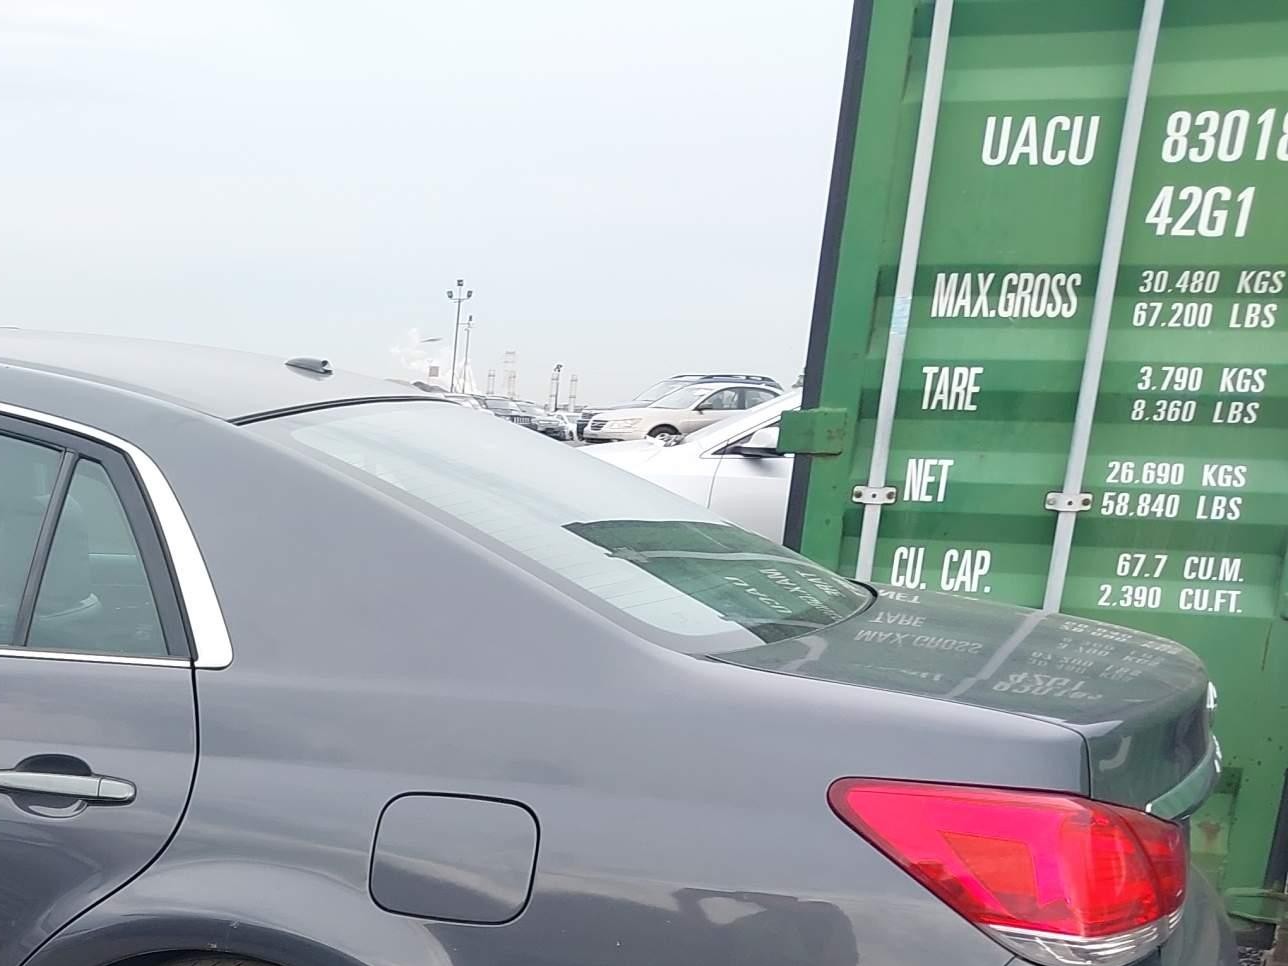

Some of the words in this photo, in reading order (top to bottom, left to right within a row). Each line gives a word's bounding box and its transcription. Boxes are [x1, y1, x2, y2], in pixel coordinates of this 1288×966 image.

[981, 115, 1100, 166] UACU
[1145, 186, 1256, 237] 42G1
[931, 273, 1082, 318] MAX.GROSS
[1139, 270, 1220, 293] 30.480
[1236, 270, 1286, 294] KGS
[1132, 302, 1213, 327] 67.200
[1229, 303, 1278, 328] LBS
[922, 366, 984, 410] TARE
[1137, 366, 1203, 391] 3.790
[1219, 367, 1267, 393] KGS
[1131, 399, 1197, 422] 8.360
[1212, 401, 1260, 424] LBS
[903, 458, 954, 502] NET
[1106, 461, 1184, 485] 26.690
[1202, 464, 1247, 487] KGS
[1101, 492, 1180, 517] 58.840
[1196, 495, 1243, 520] LBS
[890, 546, 927, 590] CU.
[940, 548, 991, 593] CAP.
[1116, 553, 1168, 578] 67.7
[1183, 556, 1244, 582] CU.M.
[1097, 584, 1162, 608] 2.390
[1178, 588, 1242, 613] CU.FT.
